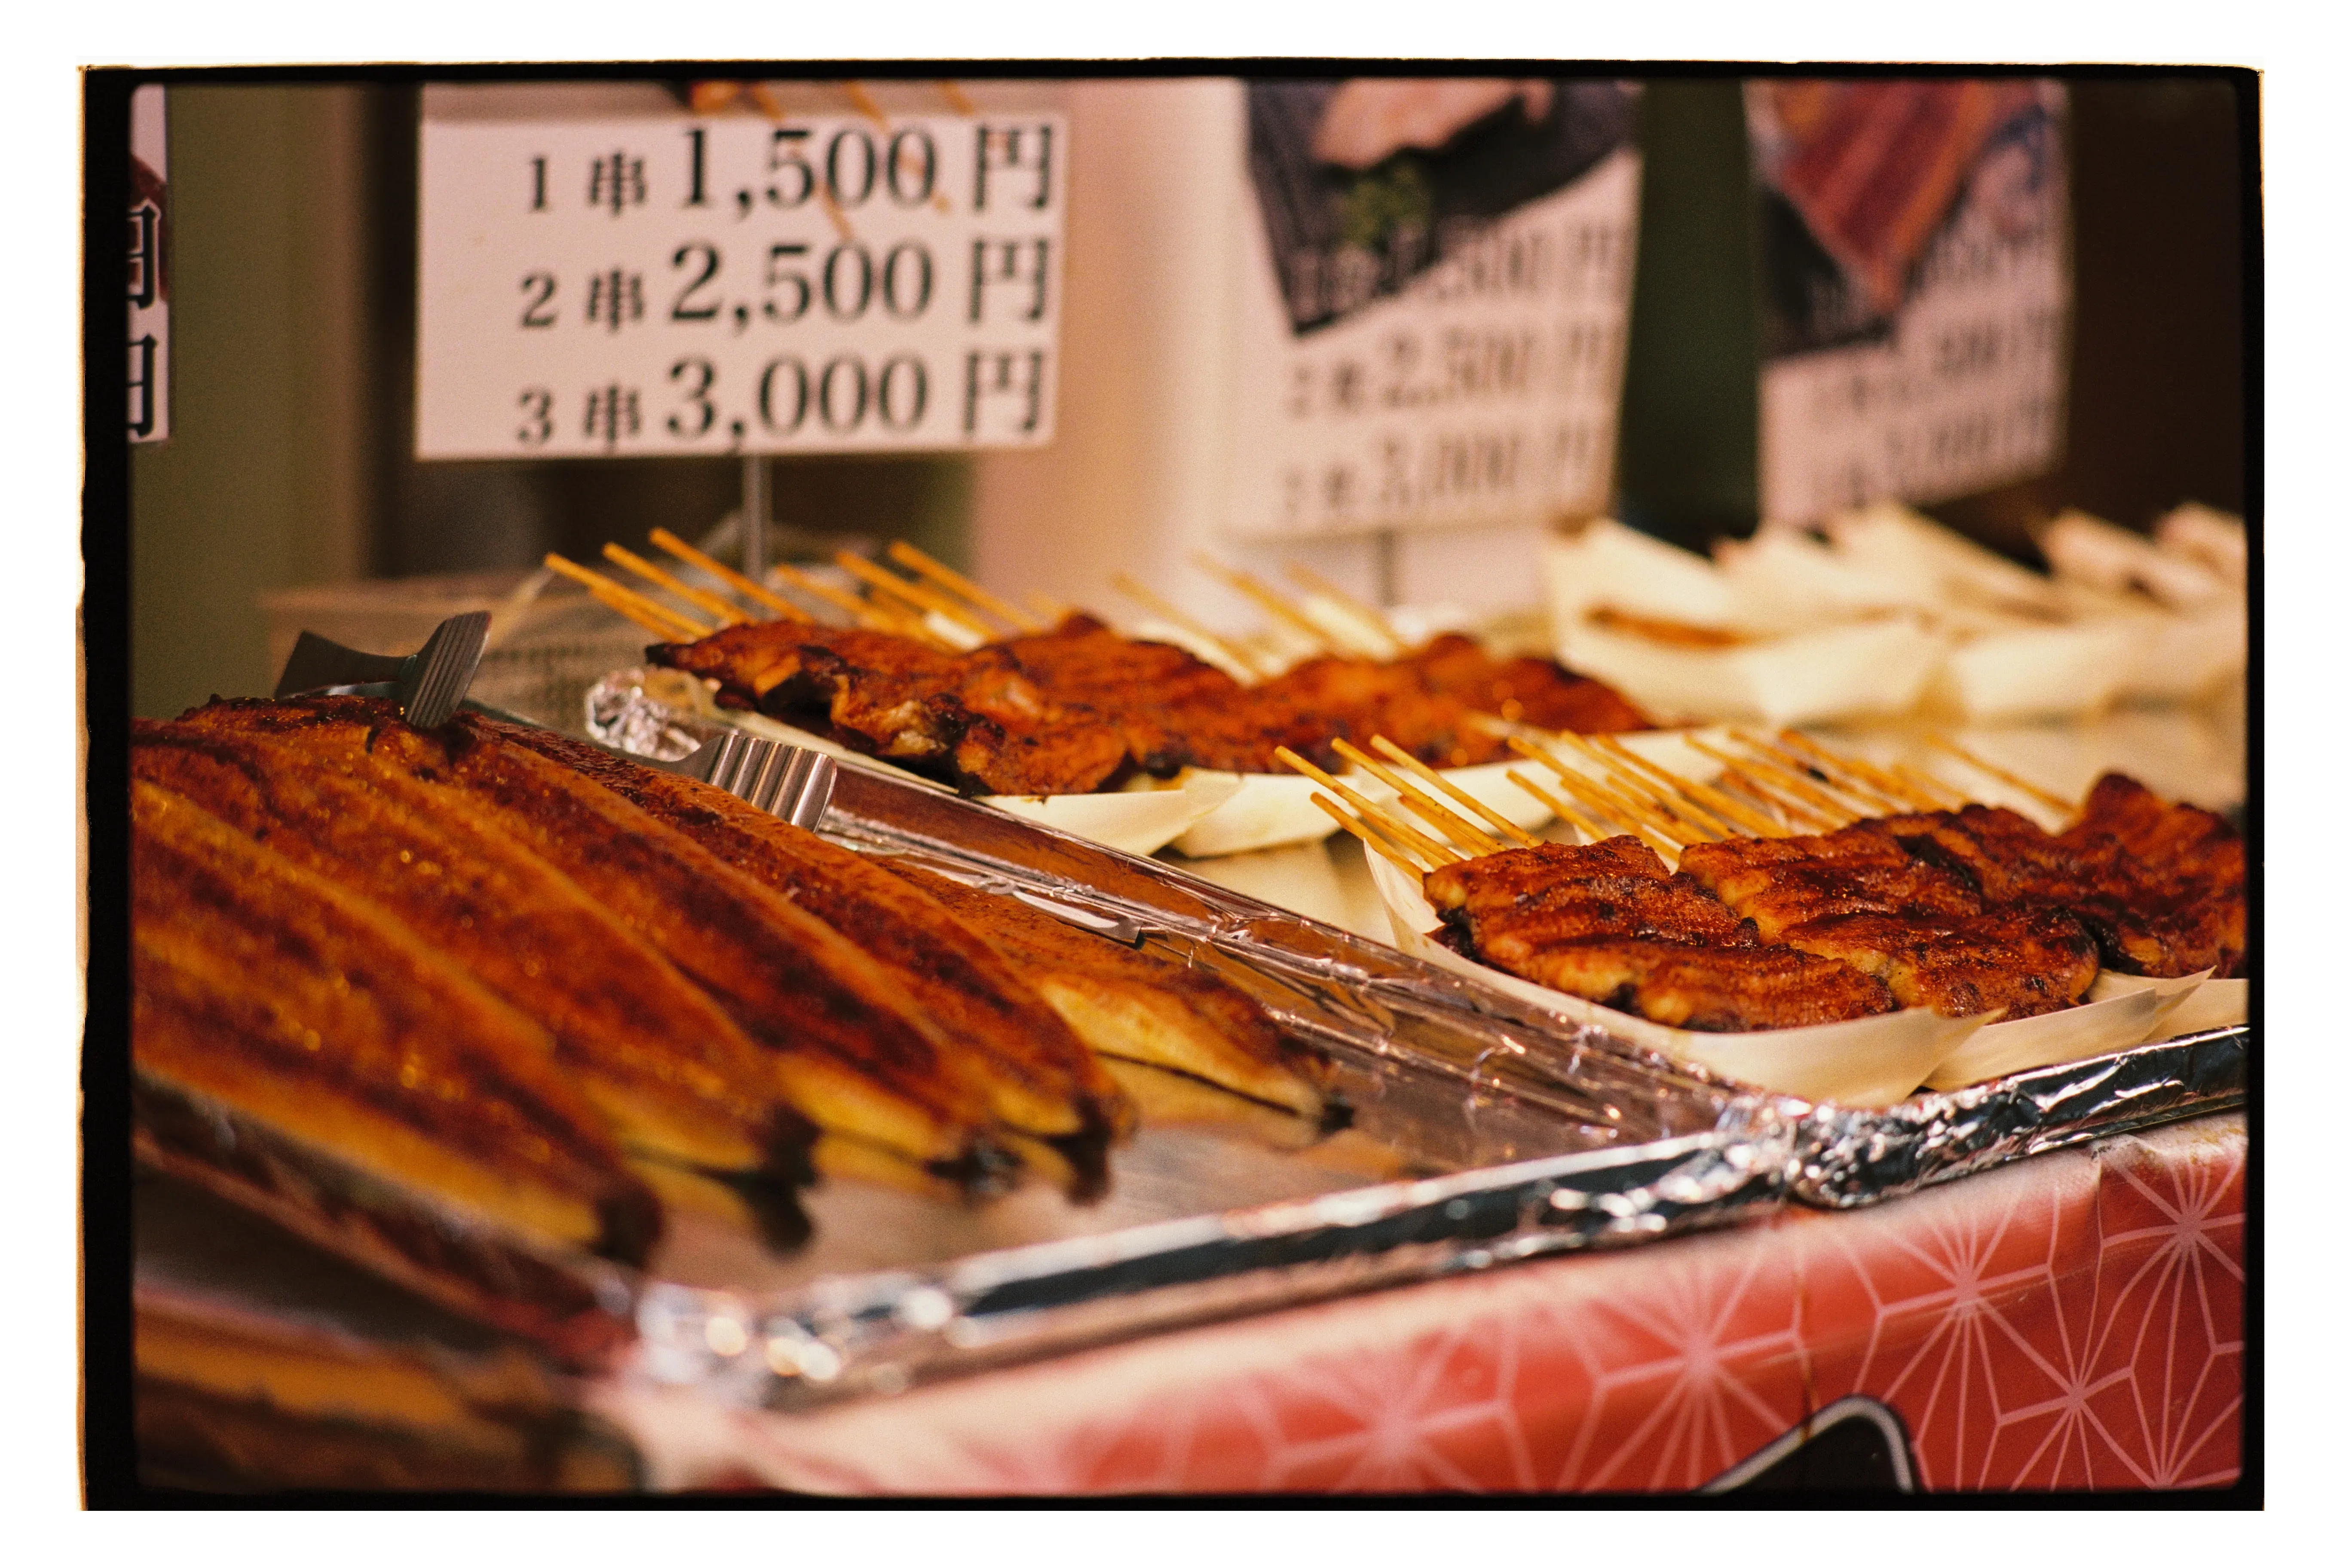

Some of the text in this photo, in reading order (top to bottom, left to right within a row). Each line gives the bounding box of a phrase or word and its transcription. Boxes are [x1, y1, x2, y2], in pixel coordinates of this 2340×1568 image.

[529, 123, 1054, 217] 1 串 1,500 円
[521, 237, 1050, 333] 2 串 2,500 円
[517, 350, 1044, 454] 3 串 3,000 円
